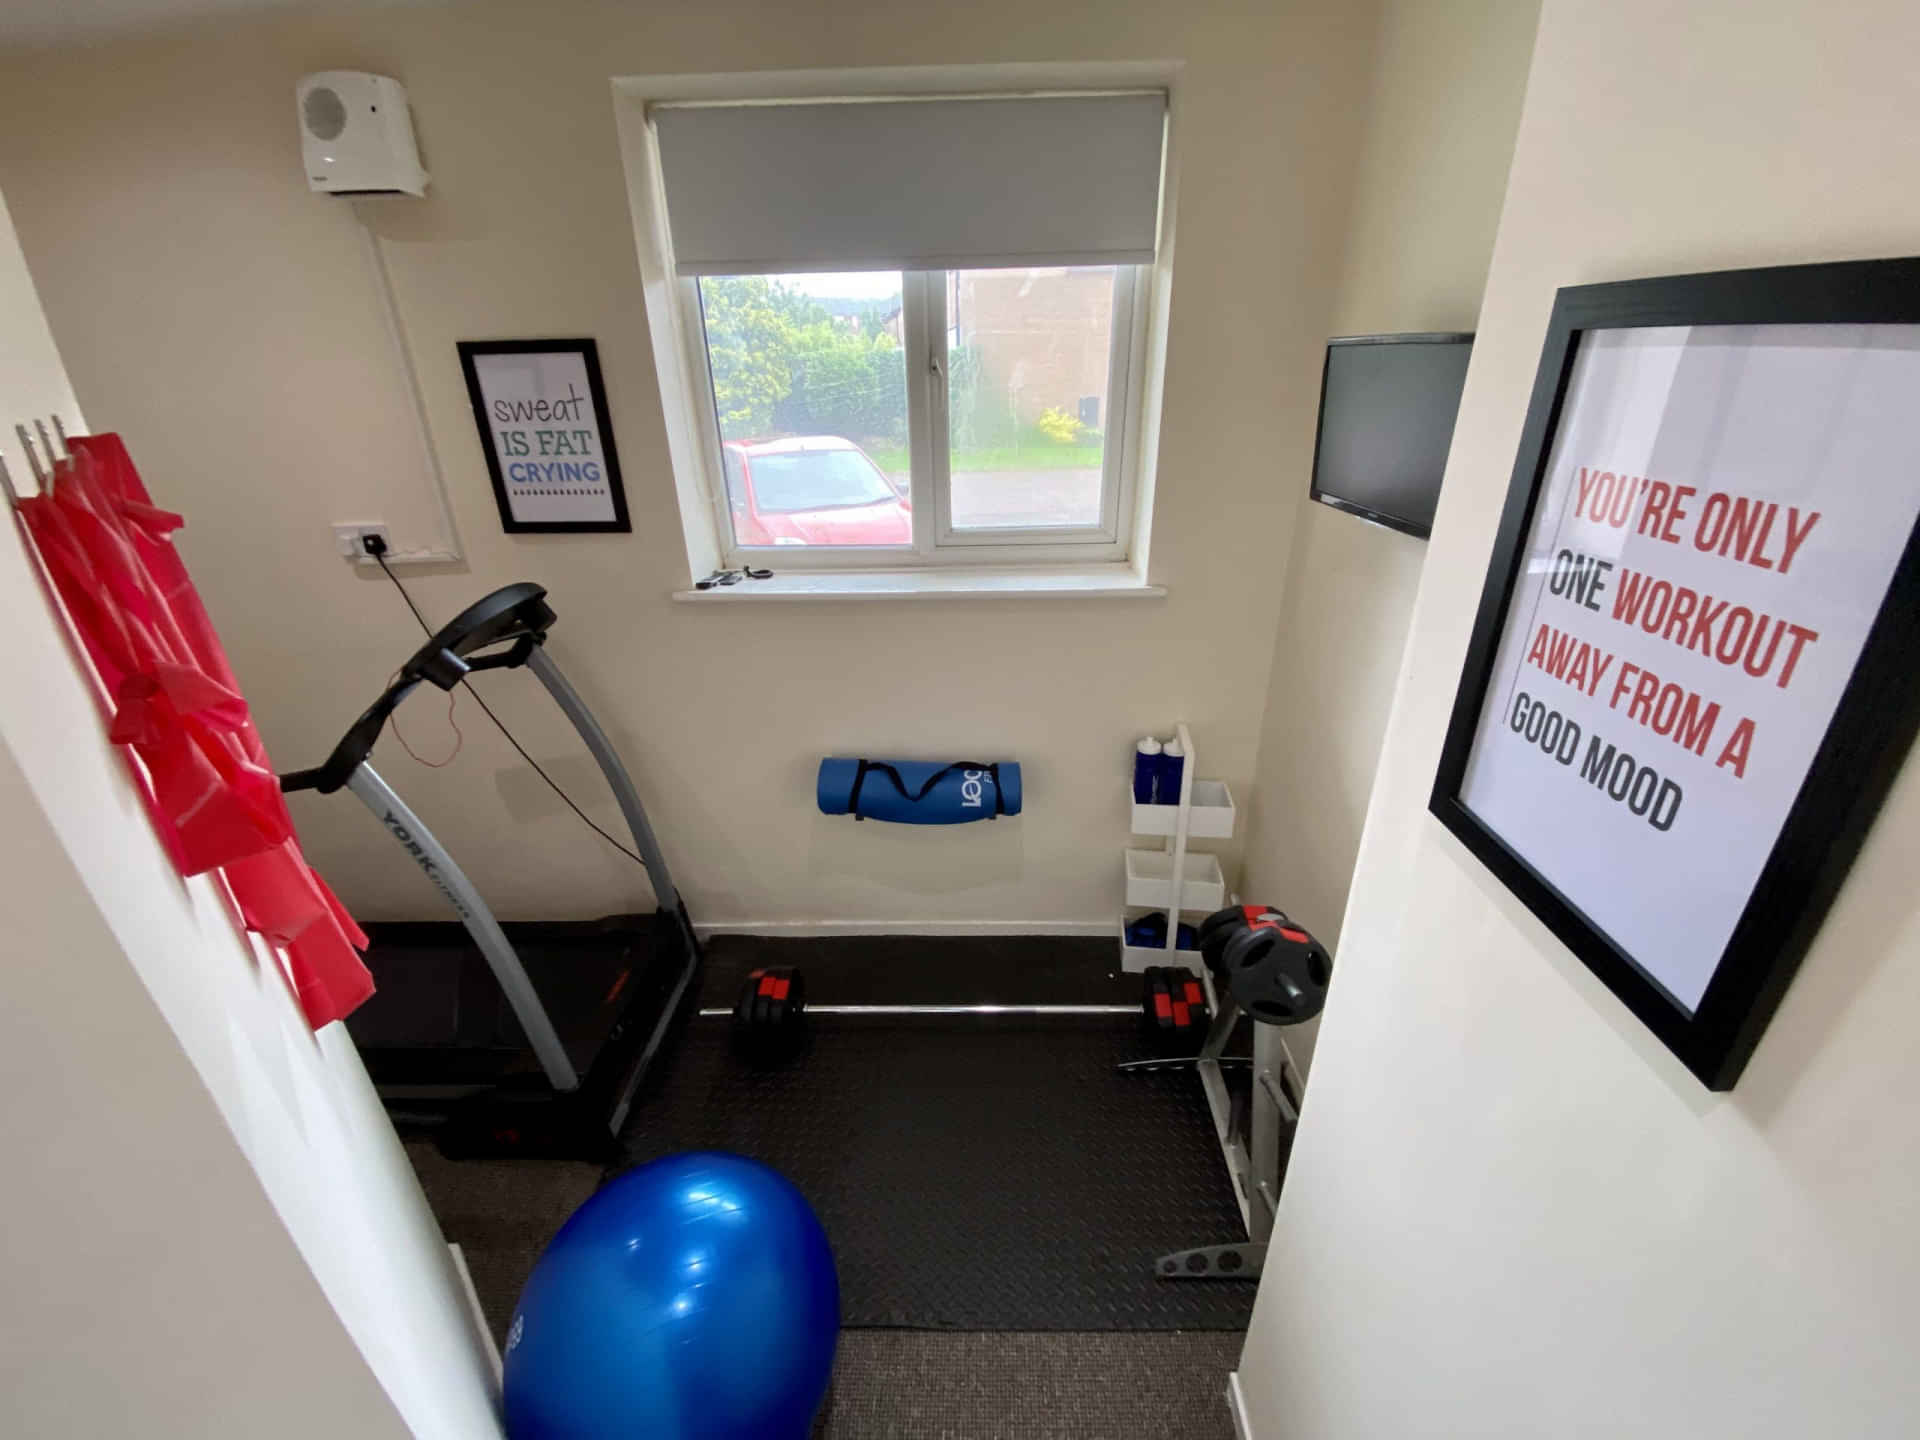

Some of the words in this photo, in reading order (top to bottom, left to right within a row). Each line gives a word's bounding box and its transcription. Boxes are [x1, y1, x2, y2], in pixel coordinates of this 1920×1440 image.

[494, 383, 584, 422] sweat
[500, 431, 530, 456] IS
[536, 430, 592, 455] FAT
[508, 462, 600, 483] CRYING
[1575, 467, 1696, 545] YOU'RE
[1694, 492, 1821, 574] ONLY
[1549, 548, 1613, 612] ONE
[1611, 568, 1818, 689] WORKOUT
[1527, 623, 1614, 696] AWAY
[1609, 662, 1721, 756] FROM
[1715, 717, 1757, 778] A
[1510, 692, 1581, 766] GOOD
[1579, 735, 1683, 832] MOOD
[384, 810, 437, 873] YORK
